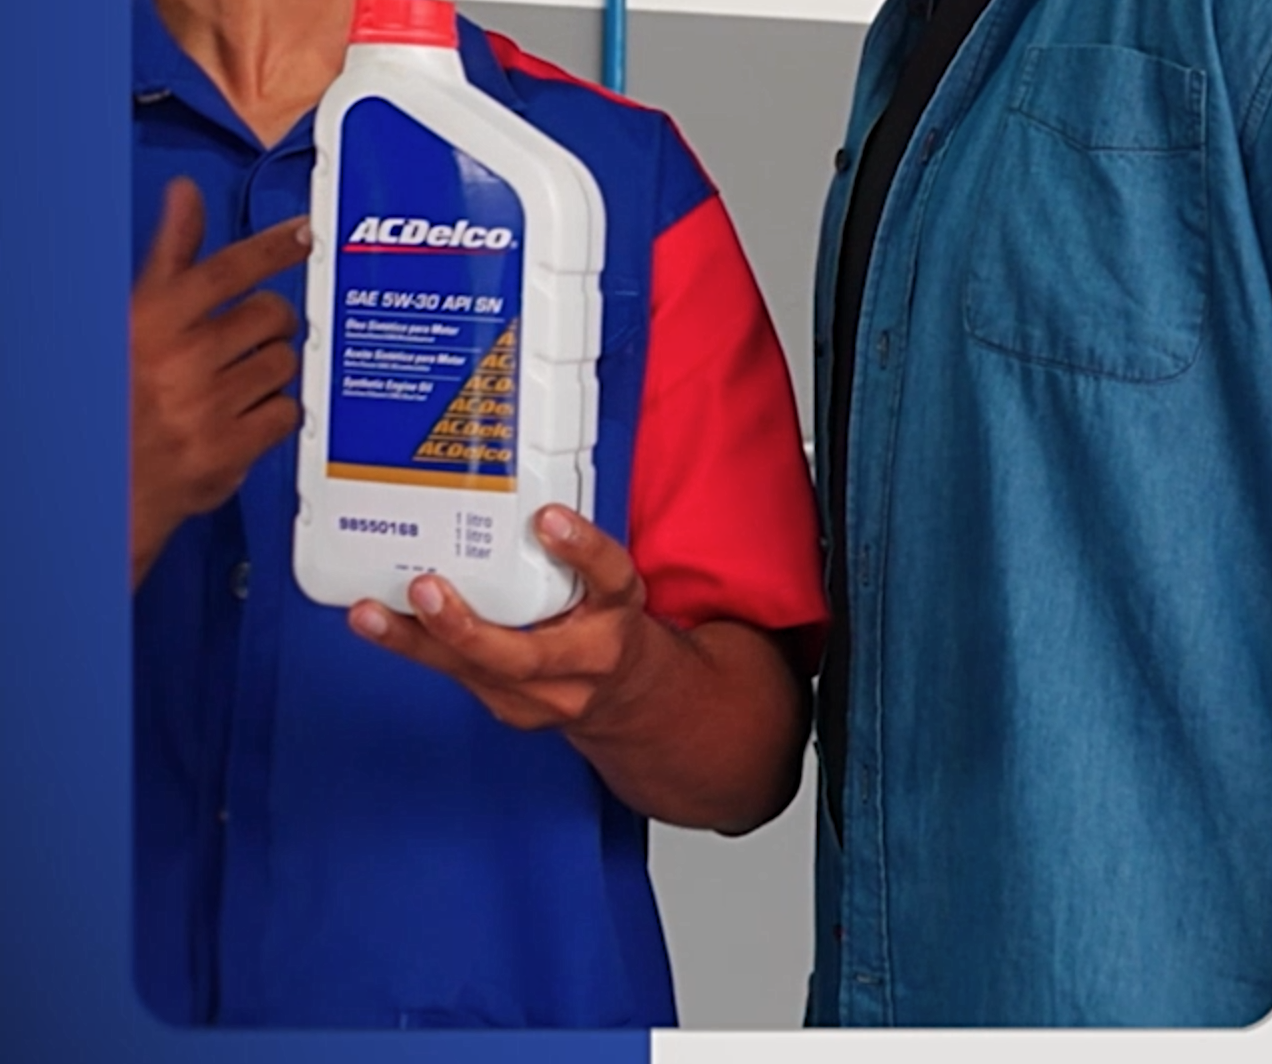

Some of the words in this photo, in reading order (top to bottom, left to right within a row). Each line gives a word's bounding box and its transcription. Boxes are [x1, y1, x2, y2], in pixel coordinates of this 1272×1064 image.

[345, 289, 379, 307] SAE
[381, 292, 440, 310] 5W-30
[441, 295, 473, 312] API
[474, 296, 504, 314] SN
[416, 440, 512, 462] ACDelco
[338, 516, 419, 537] 98550168
[465, 512, 493, 528] litro
[465, 528, 493, 544] litro
[464, 543, 492, 559] liter
